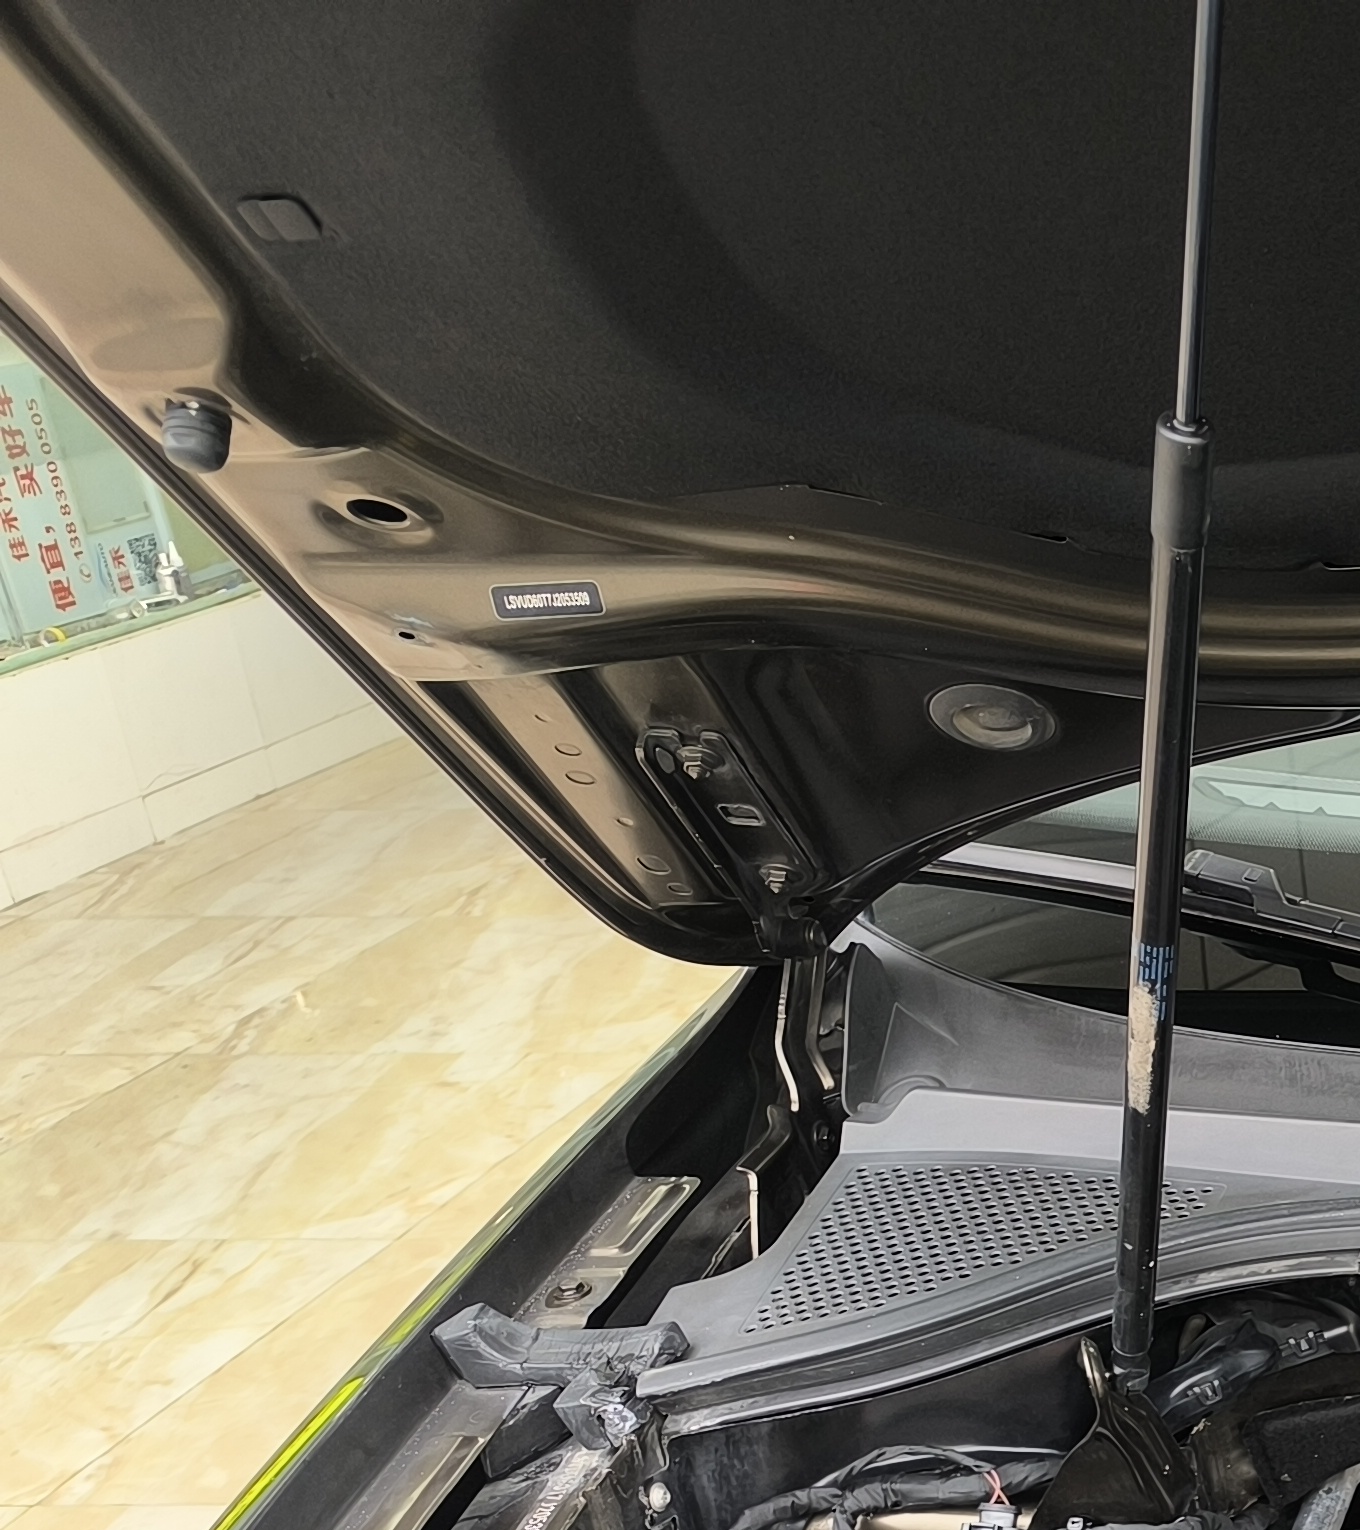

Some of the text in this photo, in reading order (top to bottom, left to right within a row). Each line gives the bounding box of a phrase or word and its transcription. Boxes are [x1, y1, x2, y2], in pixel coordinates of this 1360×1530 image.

[26, 398, 84, 559] 138 8390 0505
[109, 545, 135, 594] 佳禾
